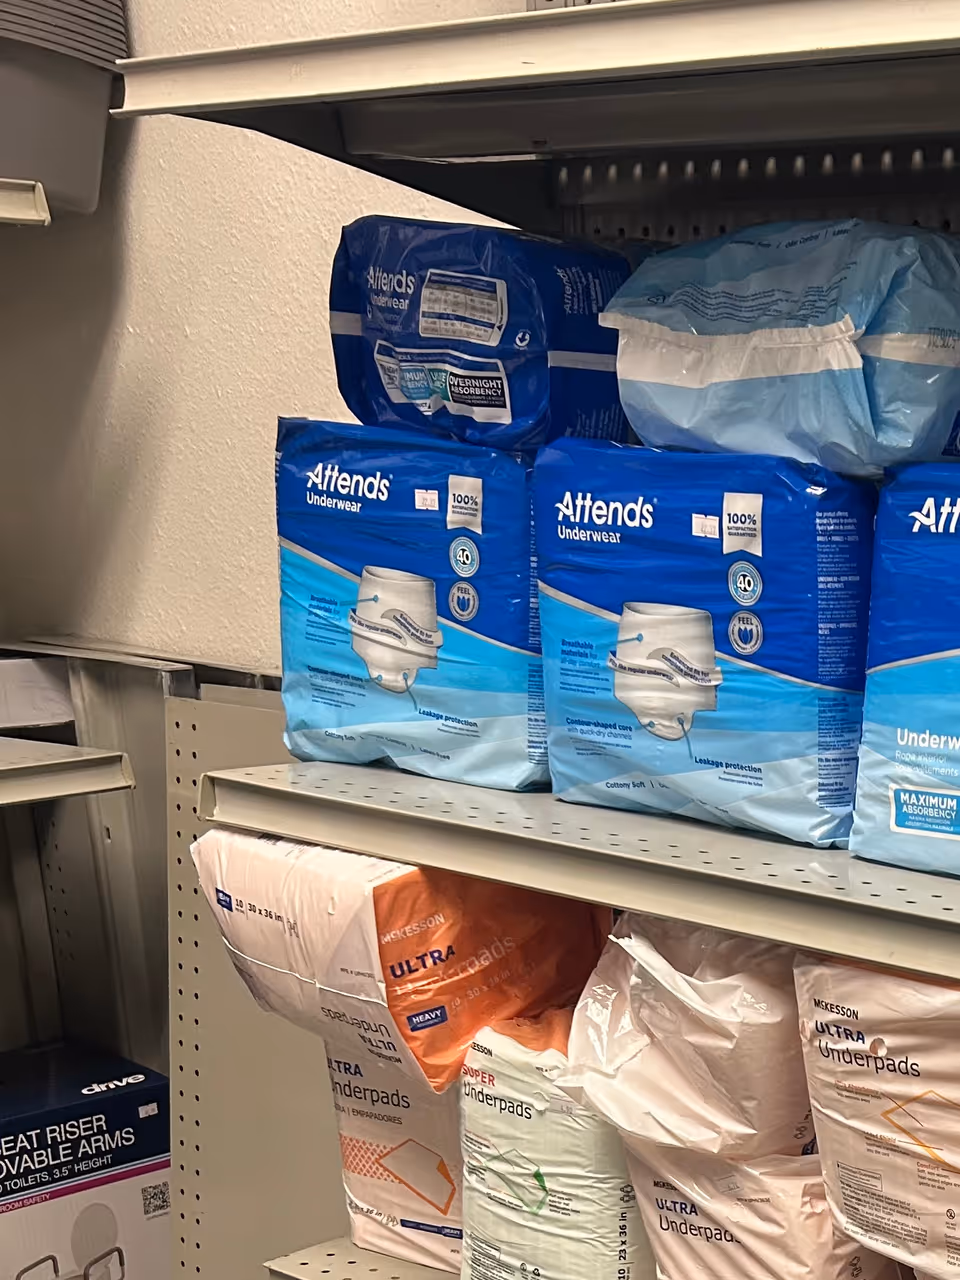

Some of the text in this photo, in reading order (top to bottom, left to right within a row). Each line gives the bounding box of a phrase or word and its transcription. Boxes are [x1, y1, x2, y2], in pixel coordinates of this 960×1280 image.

[368, 266, 414, 294] Attends
[450, 376, 502, 389] OVERNIGHT
[306, 462, 389, 501] Attends
[306, 491, 361, 513] Underwear
[452, 493, 479, 507] 100%
[555, 492, 654, 528] Attends
[727, 513, 756, 525] 100%
[557, 525, 621, 544] Underwear
[456, 549, 471, 565] 40
[737, 576, 753, 592] 40
[418, 709, 478, 728] Leakage protection
[695, 757, 761, 774] Leakage protection
[900, 792, 957, 809] MAXIMUM
[903, 805, 956, 819] ABSORBENCY
[248, 902, 273, 918] 30 36
[389, 944, 456, 980] ULTRA
[321, 1007, 391, 1037] Underpads
[412, 1009, 442, 1024] HEAVY
[815, 1020, 865, 1044] ULTRA
[818, 1039, 920, 1077] Underpads
[81, 1074, 145, 1094] drive
[462, 1064, 495, 1086] SUPER
[464, 1080, 532, 1120] Underpads
[352, 1109, 402, 1125] EMPAPADORES
[46, 1115, 106, 1144] RISER
[78, 1128, 135, 1158] ARMS
[5, 1155, 113, 1191] TOILETS, HEIGHT
[23, 1193, 50, 1207] SAFETY
[655, 1197, 698, 1216] ULTRA
[618, 1212, 627, 1280] 10 23 36 in
